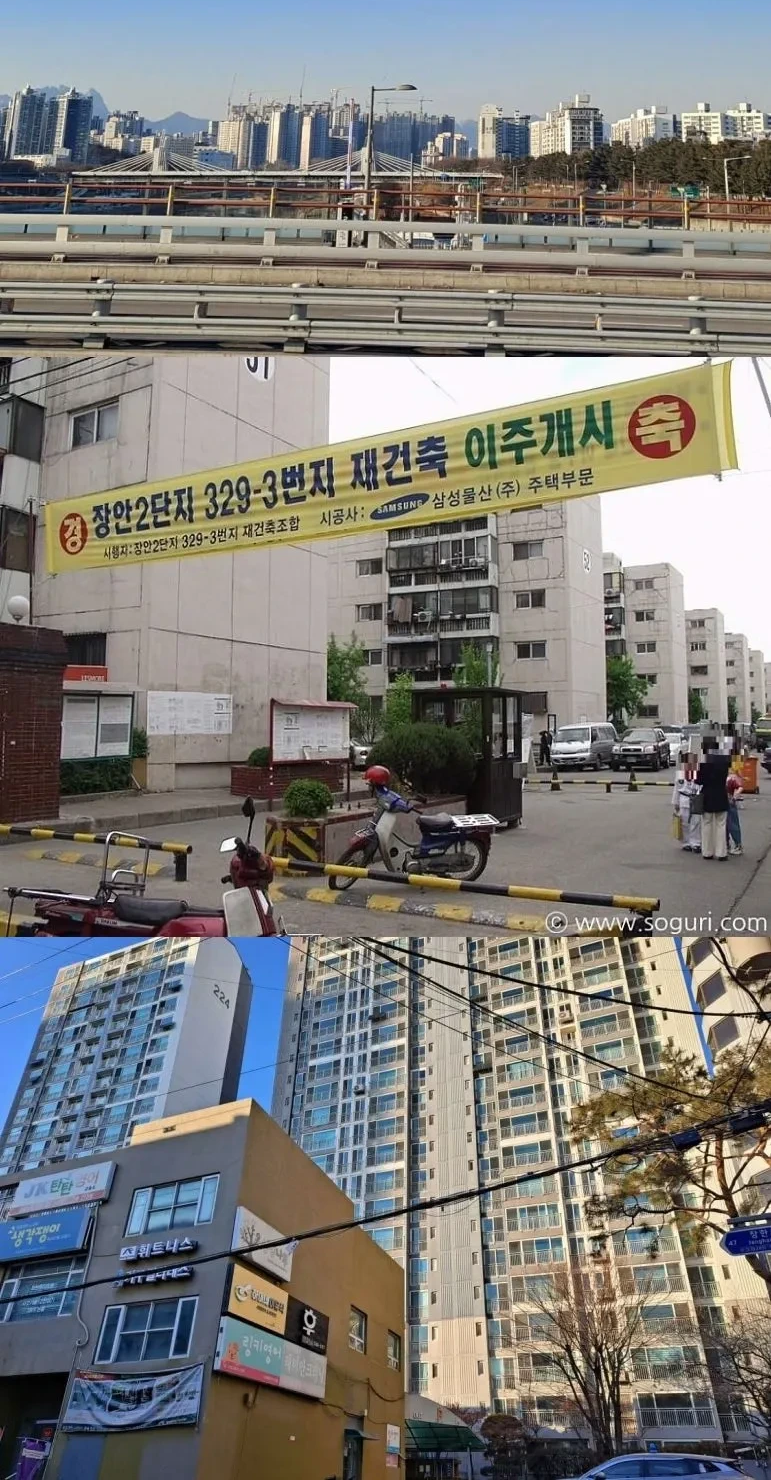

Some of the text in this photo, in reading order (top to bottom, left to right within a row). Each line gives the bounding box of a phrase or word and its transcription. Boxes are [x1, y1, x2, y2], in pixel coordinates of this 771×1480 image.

[63, 399, 685, 553] 경 장안2단지 329-3번지 재건축 이주개시 축
[432, 467, 594, 510] 삼성물산 (주) 주택부문
[377, 499, 424, 515] SAMSUNG
[181, 527, 239, 548] 329-3번지
[242, 515, 300, 538] 재건축조합
[213, 984, 230, 1010] 224
[137, 1237, 195, 1258] 휘트니스
